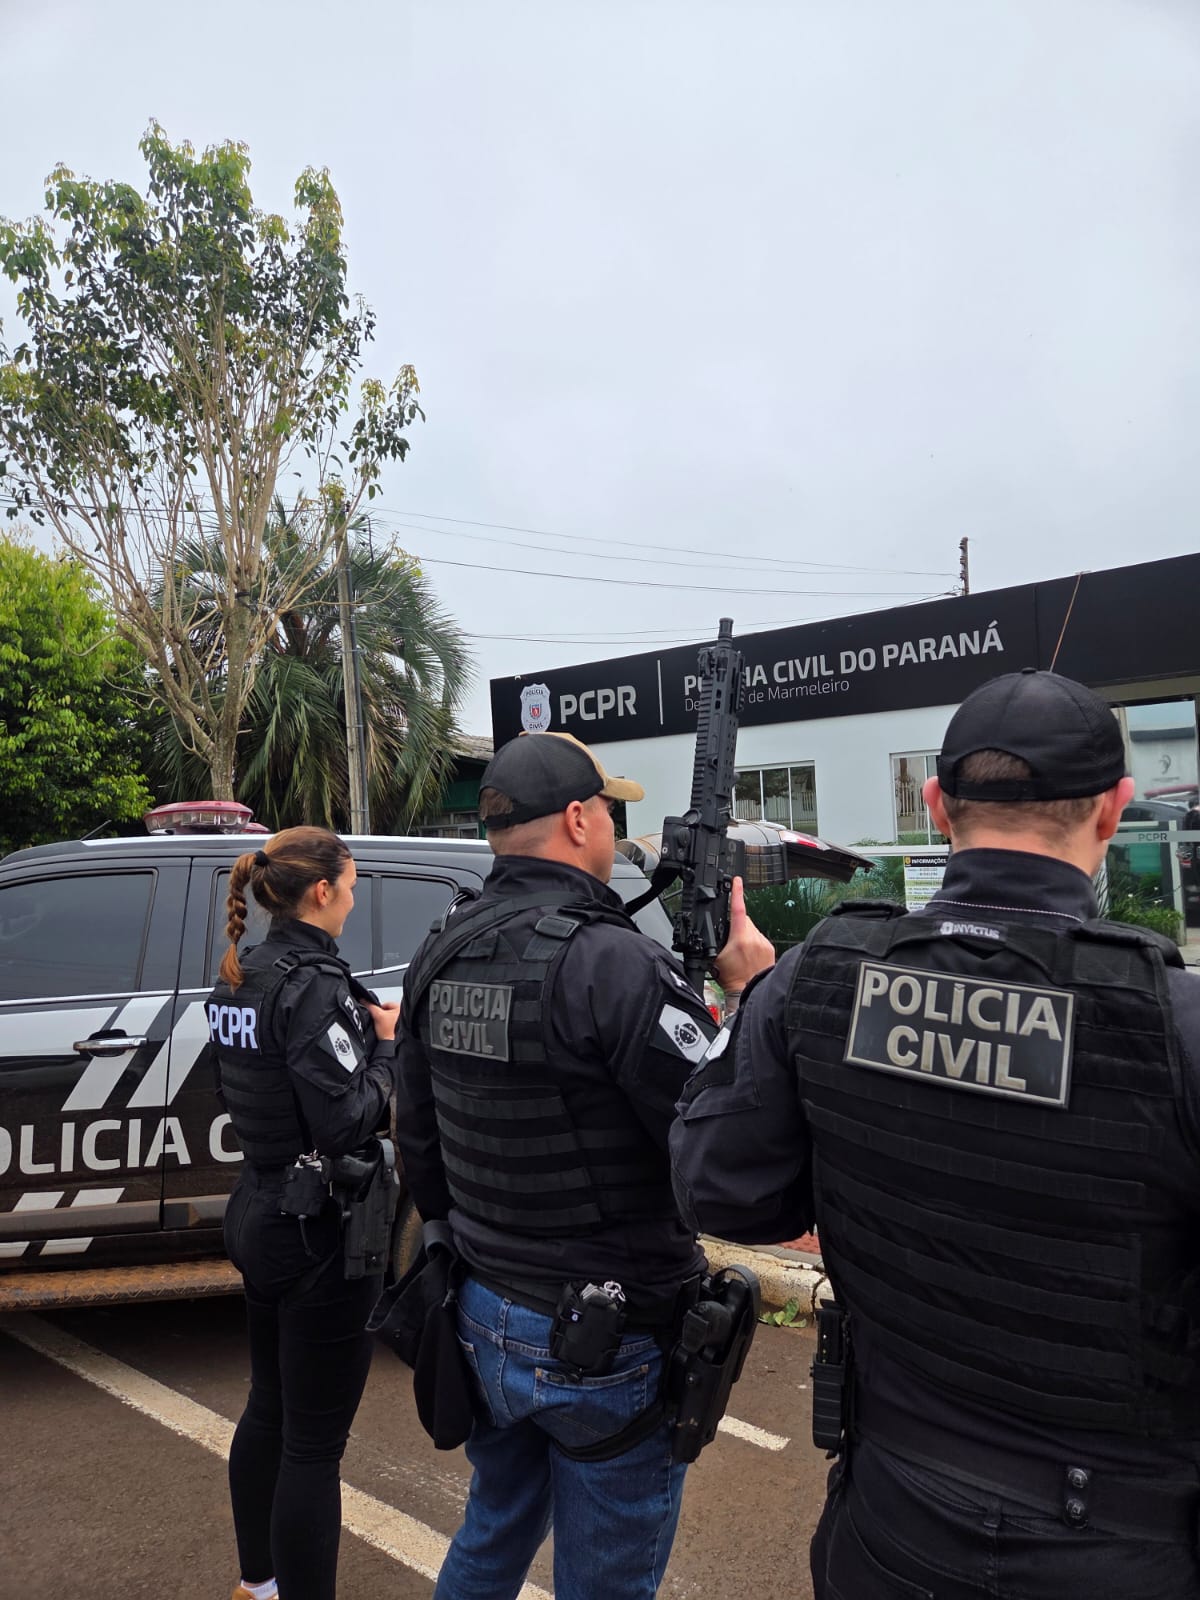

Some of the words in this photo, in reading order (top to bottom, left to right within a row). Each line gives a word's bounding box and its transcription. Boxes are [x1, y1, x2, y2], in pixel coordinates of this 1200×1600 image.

[773, 654, 834, 684] CIVIL
[840, 647, 876, 675] DO
[882, 619, 1004, 668] PARANÁ
[559, 685, 637, 725] PCPR
[748, 689, 764, 704] de
[768, 678, 850, 701] Marmeleiro
[1138, 832, 1168, 842] PCPR
[953, 922, 1000, 940] INVICTUS
[429, 982, 506, 1021] POLÍCIA
[861, 969, 1063, 1042] POLÍCIA
[208, 1003, 259, 1049] PCPR
[439, 1017, 494, 1054] CIVIL
[886, 1025, 1027, 1092] CIVIL
